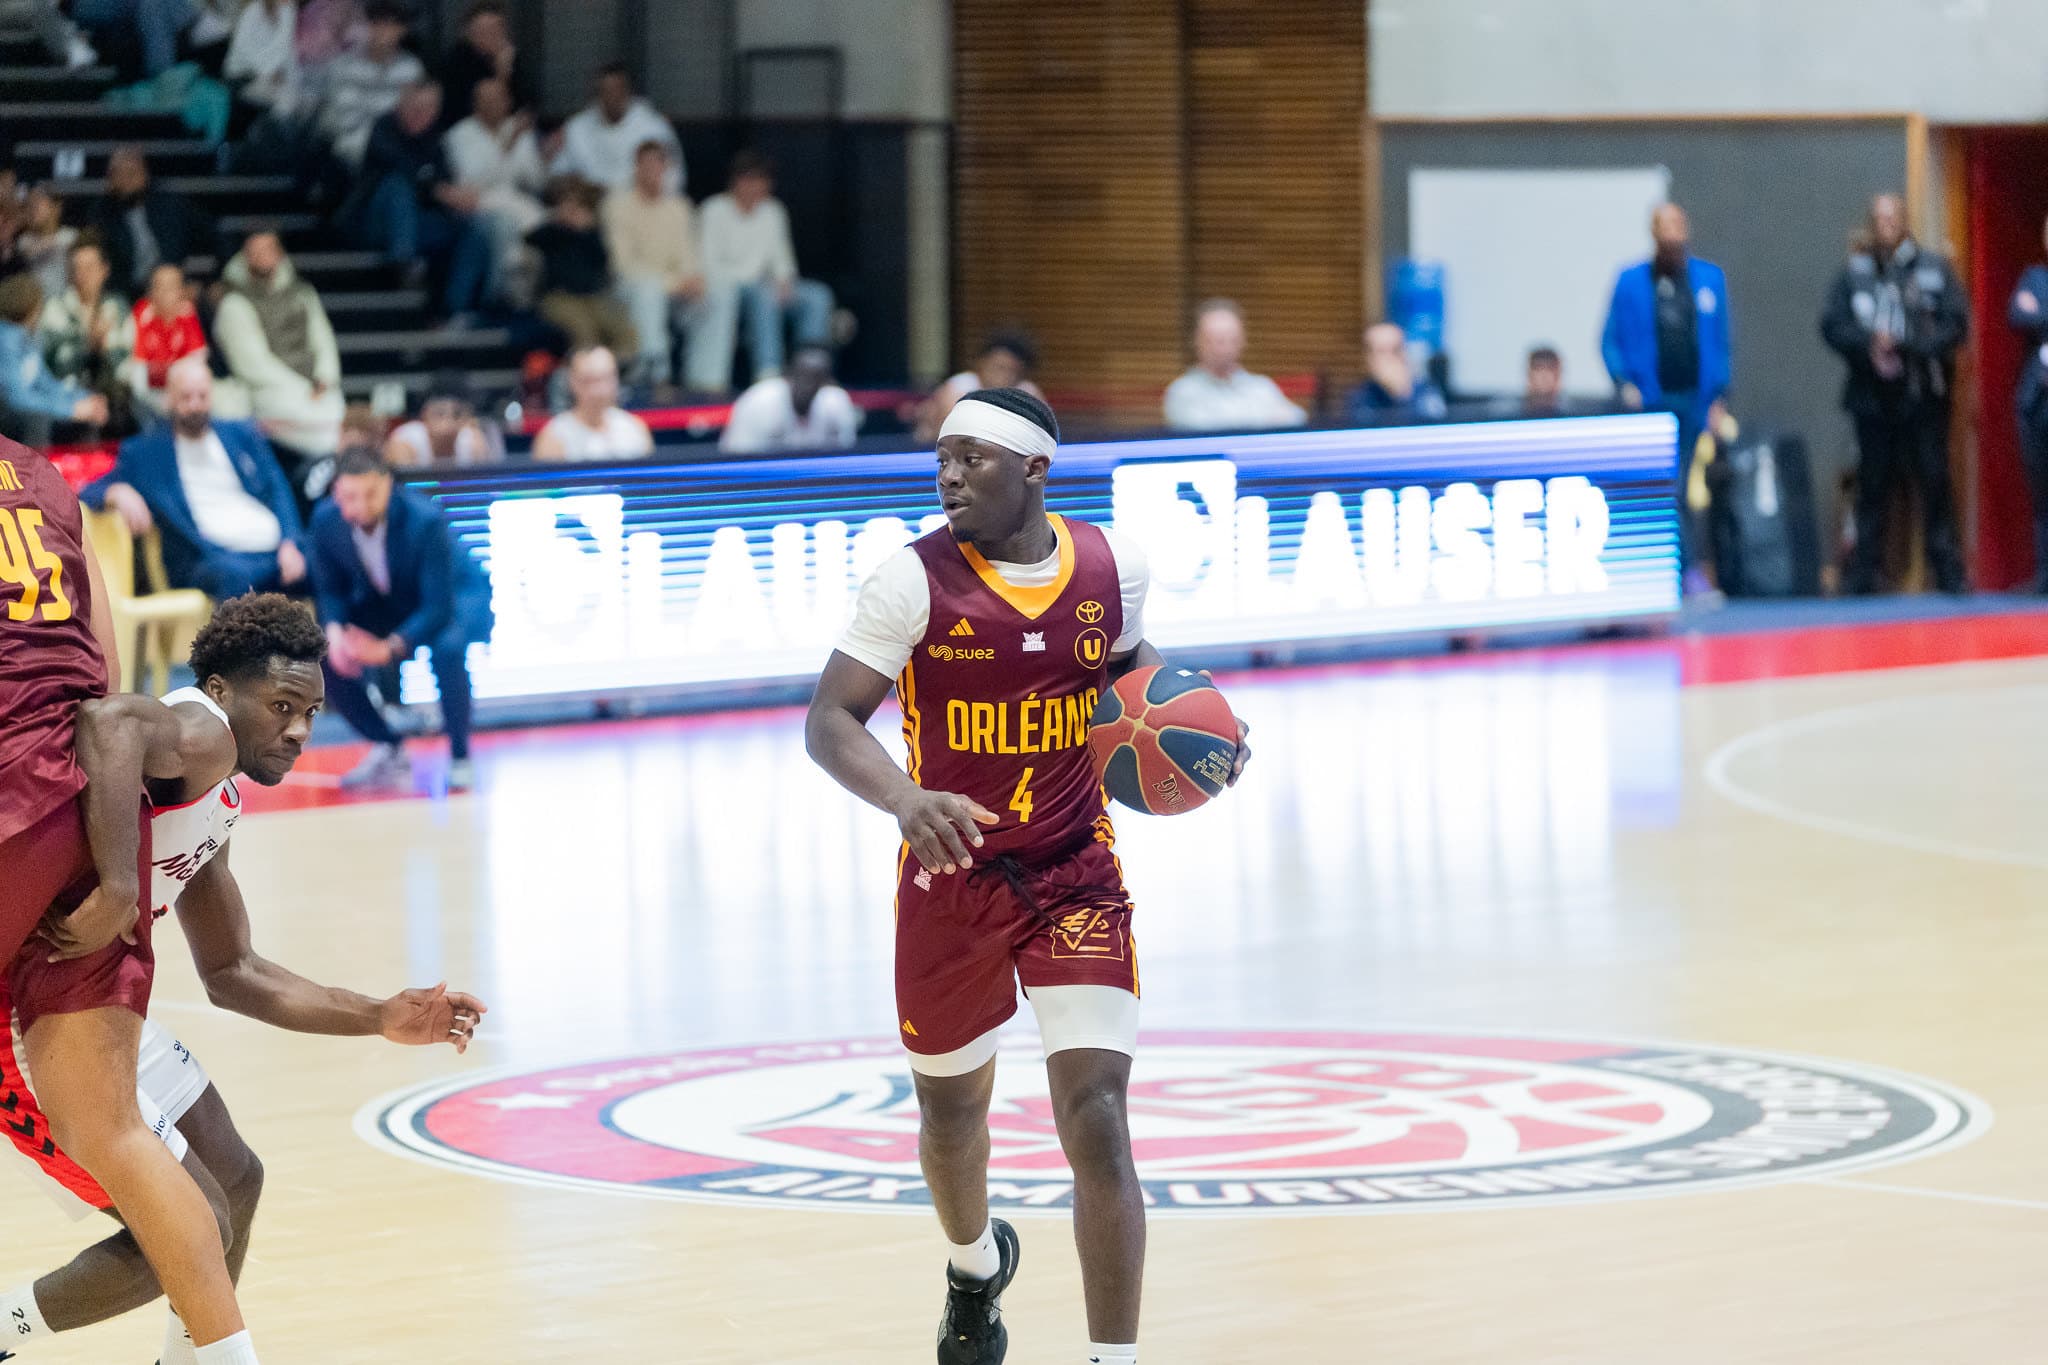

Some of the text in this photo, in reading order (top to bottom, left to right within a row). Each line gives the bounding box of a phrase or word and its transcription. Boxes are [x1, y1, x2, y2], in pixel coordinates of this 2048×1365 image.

[0, 507, 72, 622] 95
[1083, 638, 1101, 661] U
[947, 687, 1099, 755] ORLÉANS
[1008, 767, 1034, 823] 4
[985, 1159, 1692, 1205] MURIENNE
[11, 1307, 31, 1335] 23
